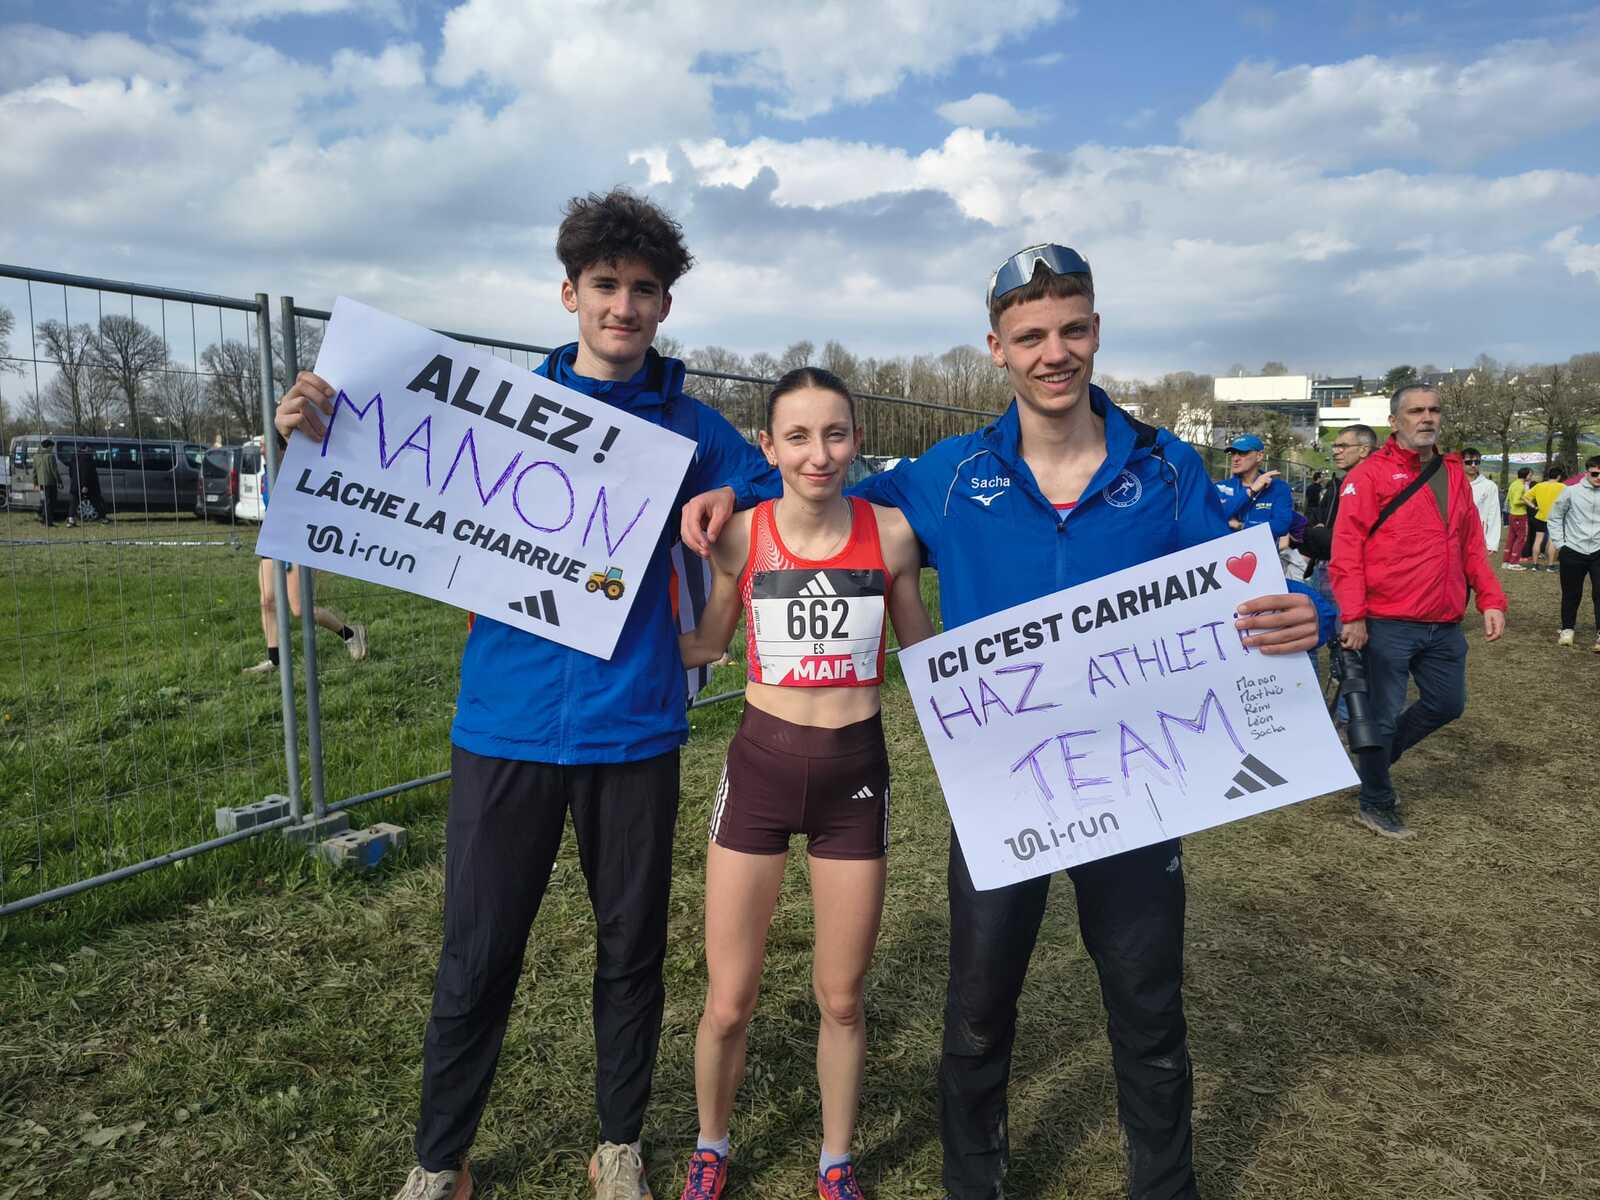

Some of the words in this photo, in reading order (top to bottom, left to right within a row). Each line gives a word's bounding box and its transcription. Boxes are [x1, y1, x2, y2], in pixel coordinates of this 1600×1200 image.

[406, 354, 594, 454] ALLEZ
[593, 426, 621, 464] !
[321, 388, 652, 558] MANON
[971, 476, 1011, 489] Sacha
[295, 468, 405, 519] LÂCHE
[404, 501, 446, 535] LA
[453, 519, 587, 583] CHARRUE
[349, 532, 416, 574] i-run
[786, 598, 850, 640] 662
[928, 643, 970, 682] ICI
[974, 612, 1064, 665] C'EST
[1071, 561, 1224, 635] CARHAIX
[813, 642, 825, 655] ES
[793, 659, 854, 681] MAIF
[1236, 674, 1277, 691] Manon
[930, 662, 1063, 740] HAZ
[1010, 688, 1248, 802] TEAM
[1251, 723, 1287, 741] Sacha
[1050, 811, 1120, 848] i-run
